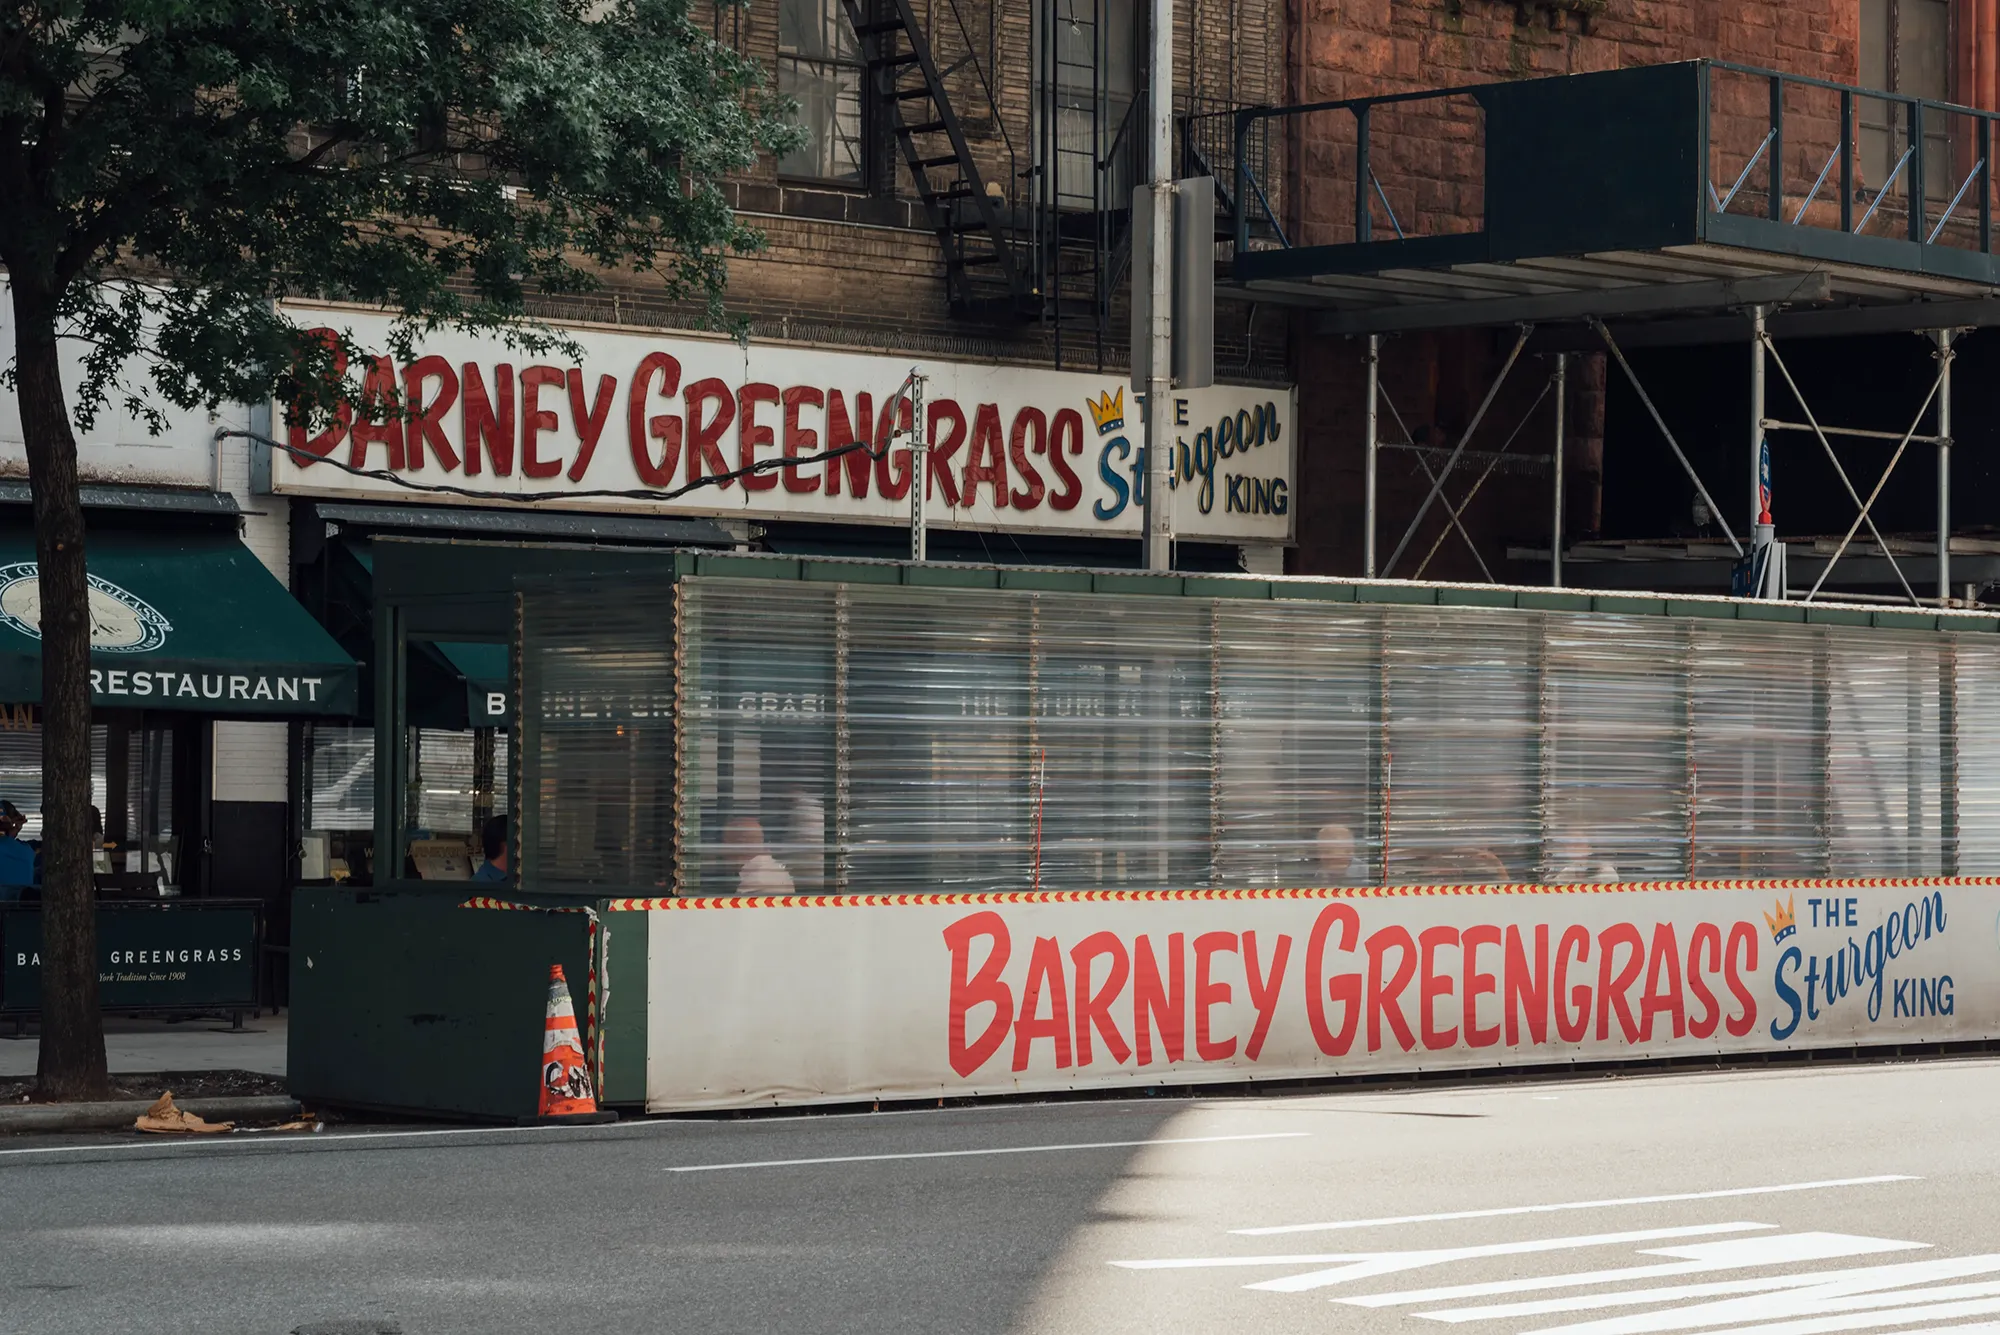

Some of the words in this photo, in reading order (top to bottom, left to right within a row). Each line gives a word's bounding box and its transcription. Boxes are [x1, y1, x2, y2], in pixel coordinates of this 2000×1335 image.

[628, 351, 1083, 511] GREENGRASS
[1135, 395, 1189, 425] TE
[1225, 473, 1288, 515] KING
[1807, 897, 1858, 927] THE
[110, 948, 242, 963] GREENGRASS
[1770, 891, 1948, 1040] Sturgeon
[99, 973, 115, 983] York
[116, 972, 147, 982] Tradition
[148, 972, 167, 981] Since
[168, 971, 186, 981] 1908
[942, 910, 1293, 1079] BARNEY
[1305, 902, 1758, 1057] GREENGRASS
[1893, 975, 1955, 1018] KING
